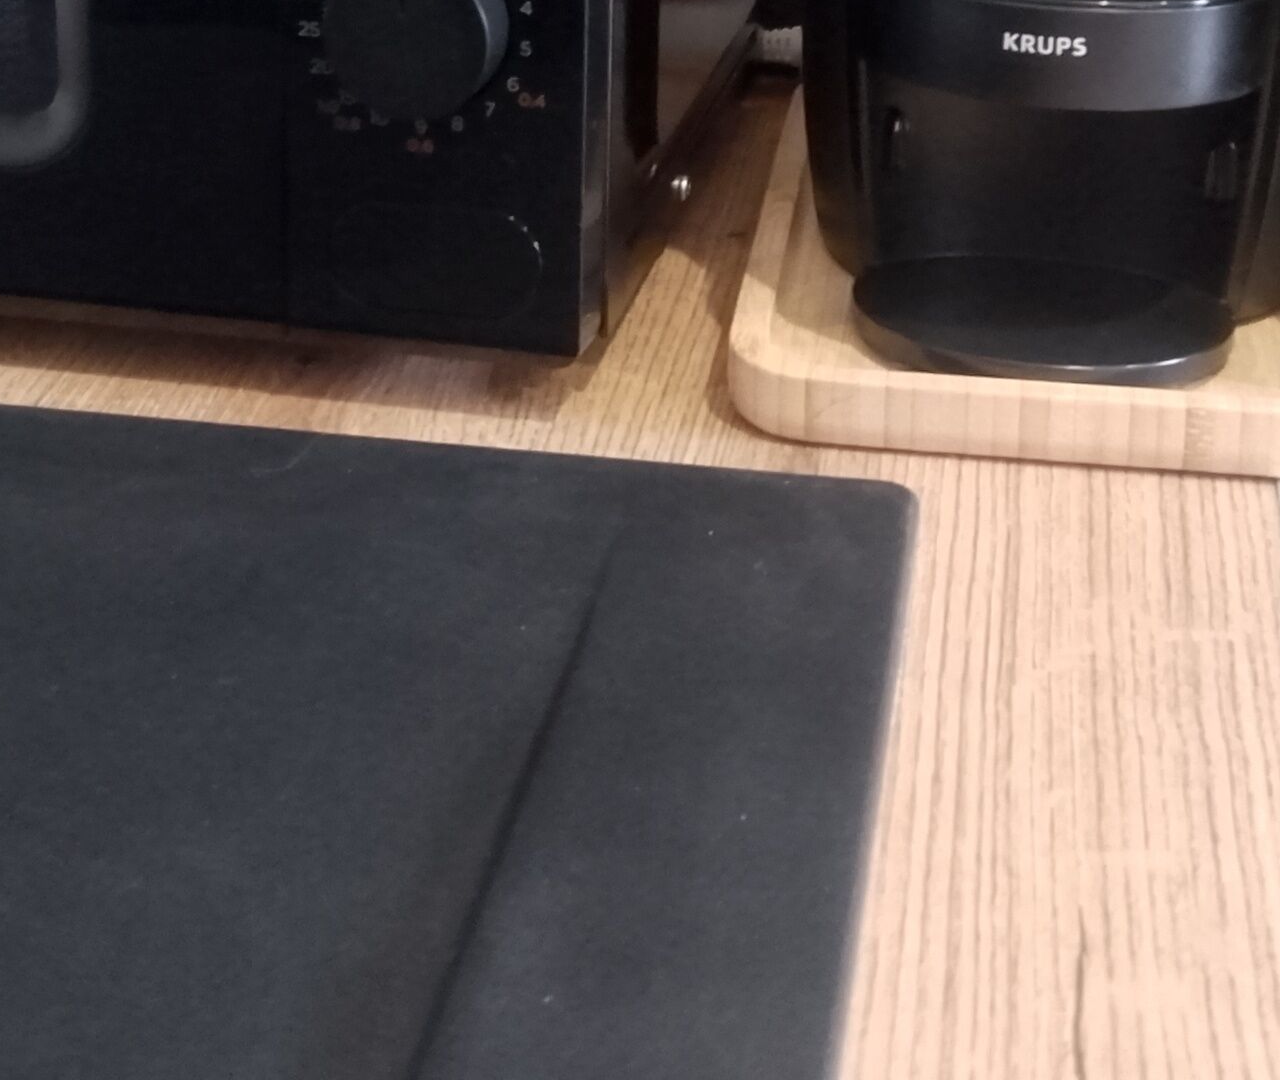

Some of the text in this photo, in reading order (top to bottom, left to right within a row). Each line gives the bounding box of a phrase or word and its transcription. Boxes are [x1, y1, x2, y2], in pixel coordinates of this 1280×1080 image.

[520, 0, 532, 17] 4
[298, 21, 321, 38] 25
[520, 40, 532, 57] 5
[1002, 31, 1088, 57] KRUPS
[507, 76, 519, 92] 6
[485, 102, 496, 118] 7
